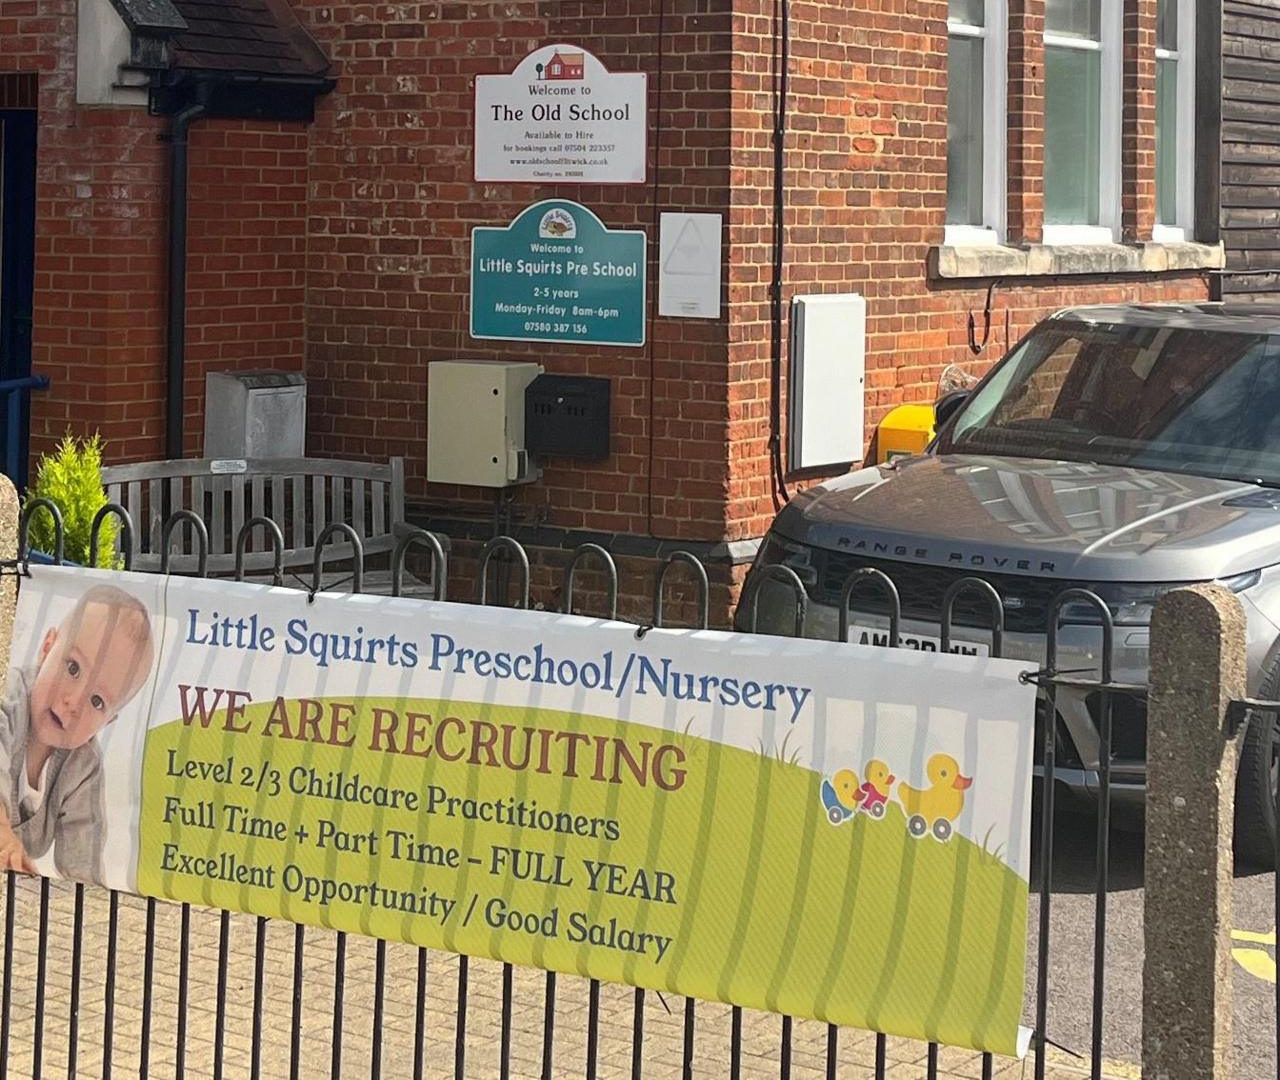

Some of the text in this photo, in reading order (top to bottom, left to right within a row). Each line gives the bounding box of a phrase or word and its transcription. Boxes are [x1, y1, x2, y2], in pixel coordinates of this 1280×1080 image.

[528, 85, 592, 96] Welcome to
[491, 103, 630, 121] The Old School
[524, 131, 594, 139] Available to Hire
[503, 144, 513, 152] for
[515, 144, 547, 153] bookings
[549, 144, 562, 152] call
[531, 243, 584, 254] Welcome to
[479, 258, 637, 277] Little Squirts Pre School
[533, 287, 580, 300] 2-5 years
[495, 302, 619, 319] Monday-Friday 8am-6pm
[524, 321, 588, 334] 07580 387 156
[837, 536, 1056, 572] RANGE ROVER
[186, 608, 276, 652] Little
[285, 618, 418, 668] Squirts
[428, 633, 812, 724] Preschool/Nursery
[178, 684, 689, 792] WE ARE RECRUITING
[166, 749, 621, 841] Level 2/3 Childcare Practitioners
[163, 796, 215, 830] Full
[223, 804, 288, 842] Time
[294, 825, 309, 844] +
[316, 820, 380, 856] Part
[386, 830, 460, 869] Time
[489, 845, 574, 887] FULL
[582, 859, 678, 905] YEAR
[160, 843, 674, 965] Excellent Opportunity / Good Salary
